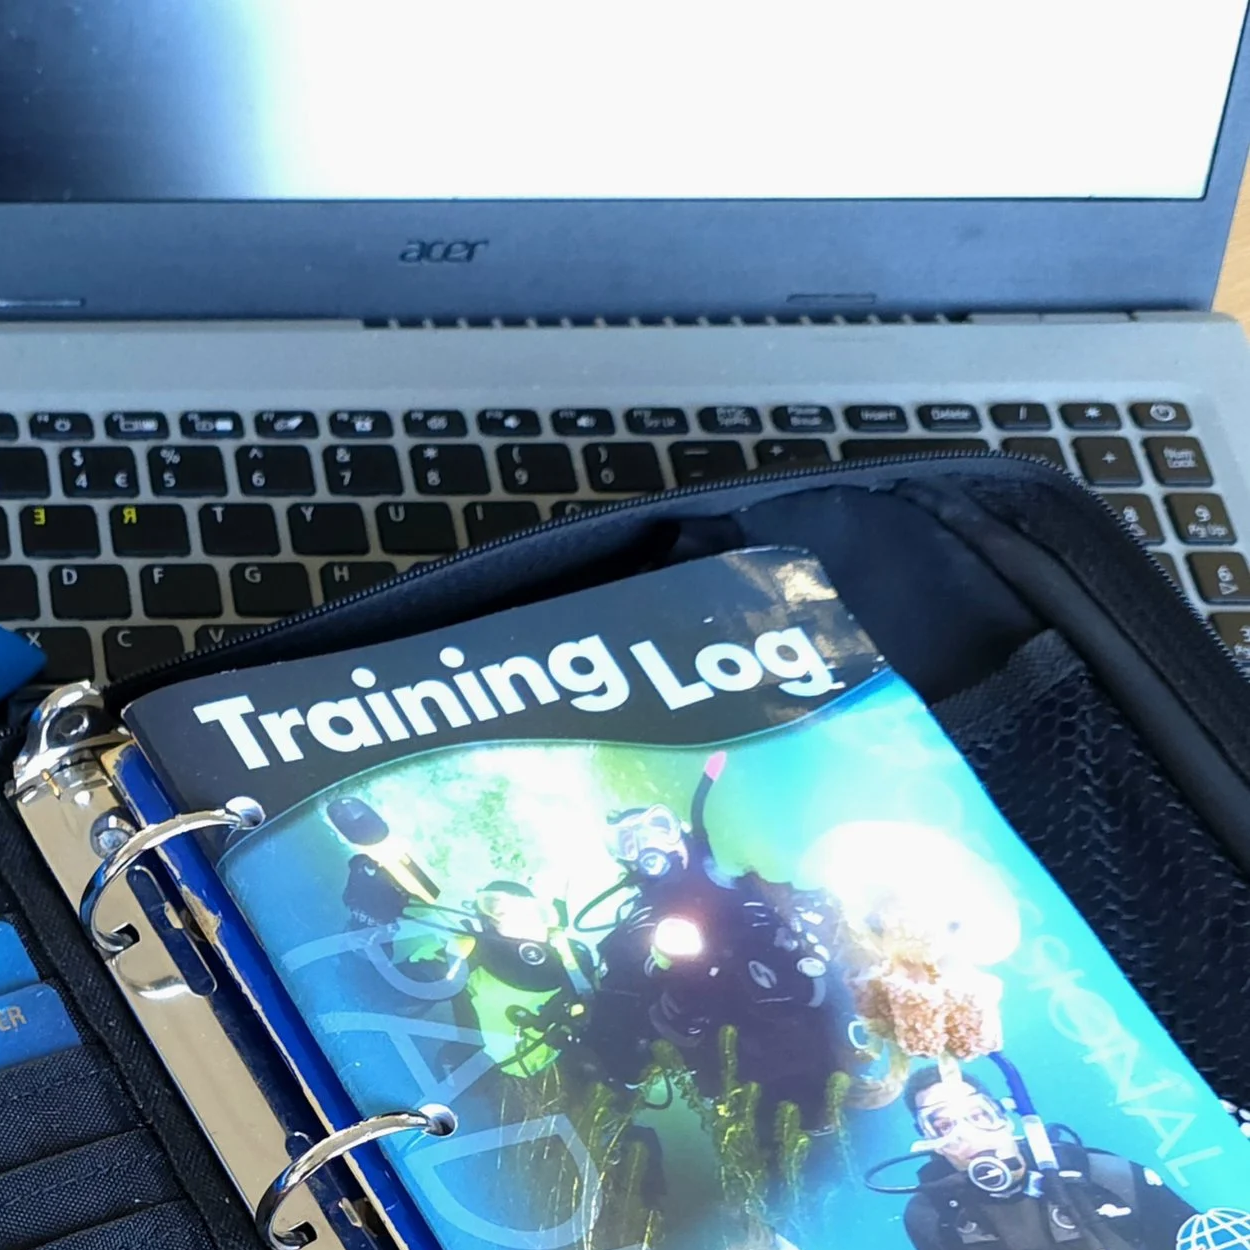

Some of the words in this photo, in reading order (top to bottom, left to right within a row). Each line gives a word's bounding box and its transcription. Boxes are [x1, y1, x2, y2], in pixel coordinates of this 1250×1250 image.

[399, 238, 490, 263] acer
[75, 472, 88, 488] 4
[163, 470, 176, 488] 5
[252, 470, 265, 487] 6
[340, 470, 352, 486] 7
[514, 468, 528, 485] 9
[212, 506, 225, 523] T
[300, 506, 314, 522] Y
[388, 505, 406, 522] U
[477, 505, 484, 521] I
[1195, 505, 1211, 522] 9
[62, 568, 78, 585] D
[153, 568, 165, 584] F
[244, 566, 261, 583] G
[333, 566, 349, 582] H
[26, 632, 42, 648] X
[118, 630, 132, 647] C
[209, 628, 225, 643] V
[193, 634, 631, 771] Training
[630, 626, 848, 711] Log
